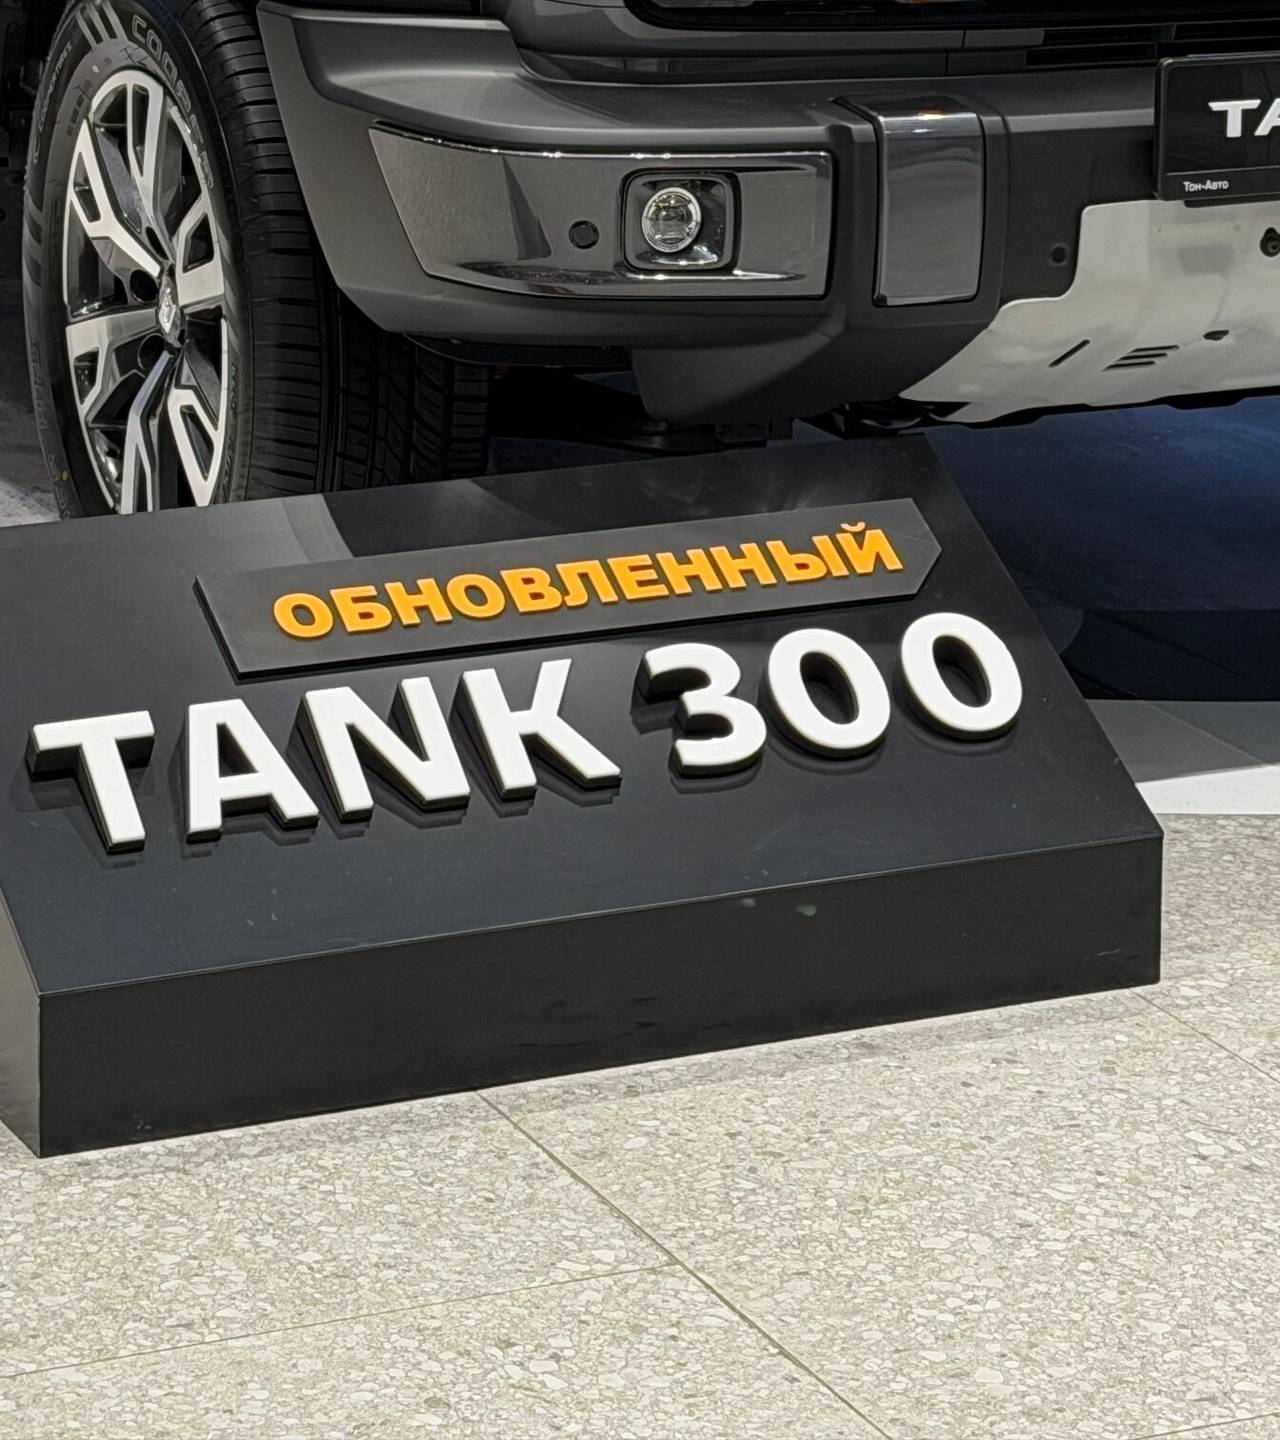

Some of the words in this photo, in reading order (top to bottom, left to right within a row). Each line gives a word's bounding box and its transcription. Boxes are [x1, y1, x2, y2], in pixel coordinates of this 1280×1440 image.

[272, 522, 904, 641] ОБНОВЛЕННЫЙ
[28, 657, 622, 854] TANK
[636, 611, 1026, 777] 300
